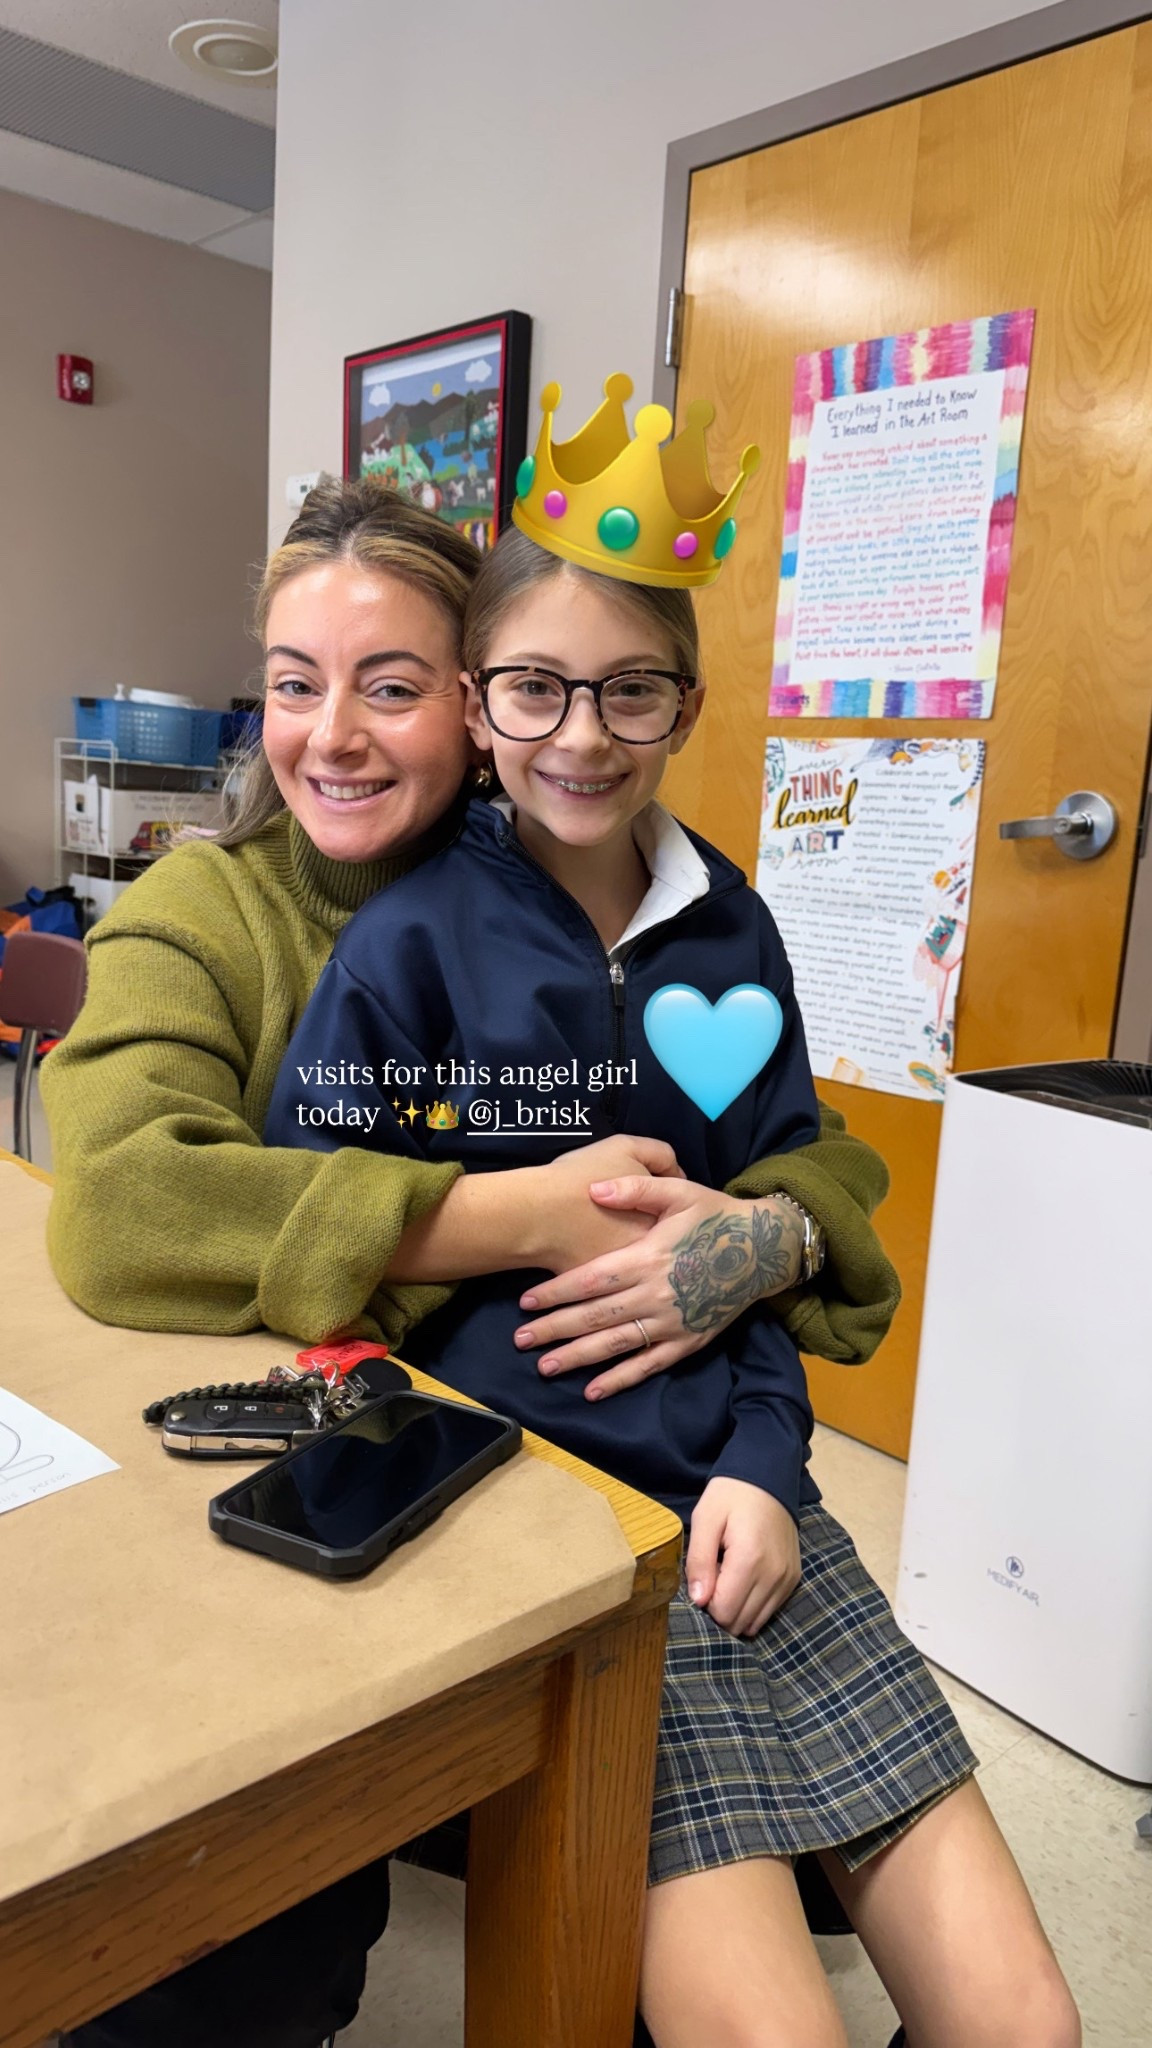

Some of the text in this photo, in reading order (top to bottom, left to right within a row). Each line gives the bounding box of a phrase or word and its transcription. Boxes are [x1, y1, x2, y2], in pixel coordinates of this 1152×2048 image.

[826, 390, 977, 423] Everything I needed to Know
[830, 424, 838, 438] I
[843, 416, 878, 435] learned
[884, 419, 896, 430] in
[917, 411, 935, 426] Art
[940, 406, 968, 421] Room
[916, 437, 937, 449] about
[938, 435, 979, 446] something
[927, 451, 938, 461] all
[939, 450, 952, 459] the
[790, 768, 843, 804] THING
[771, 777, 859, 830] learned
[792, 830, 845, 854] ART
